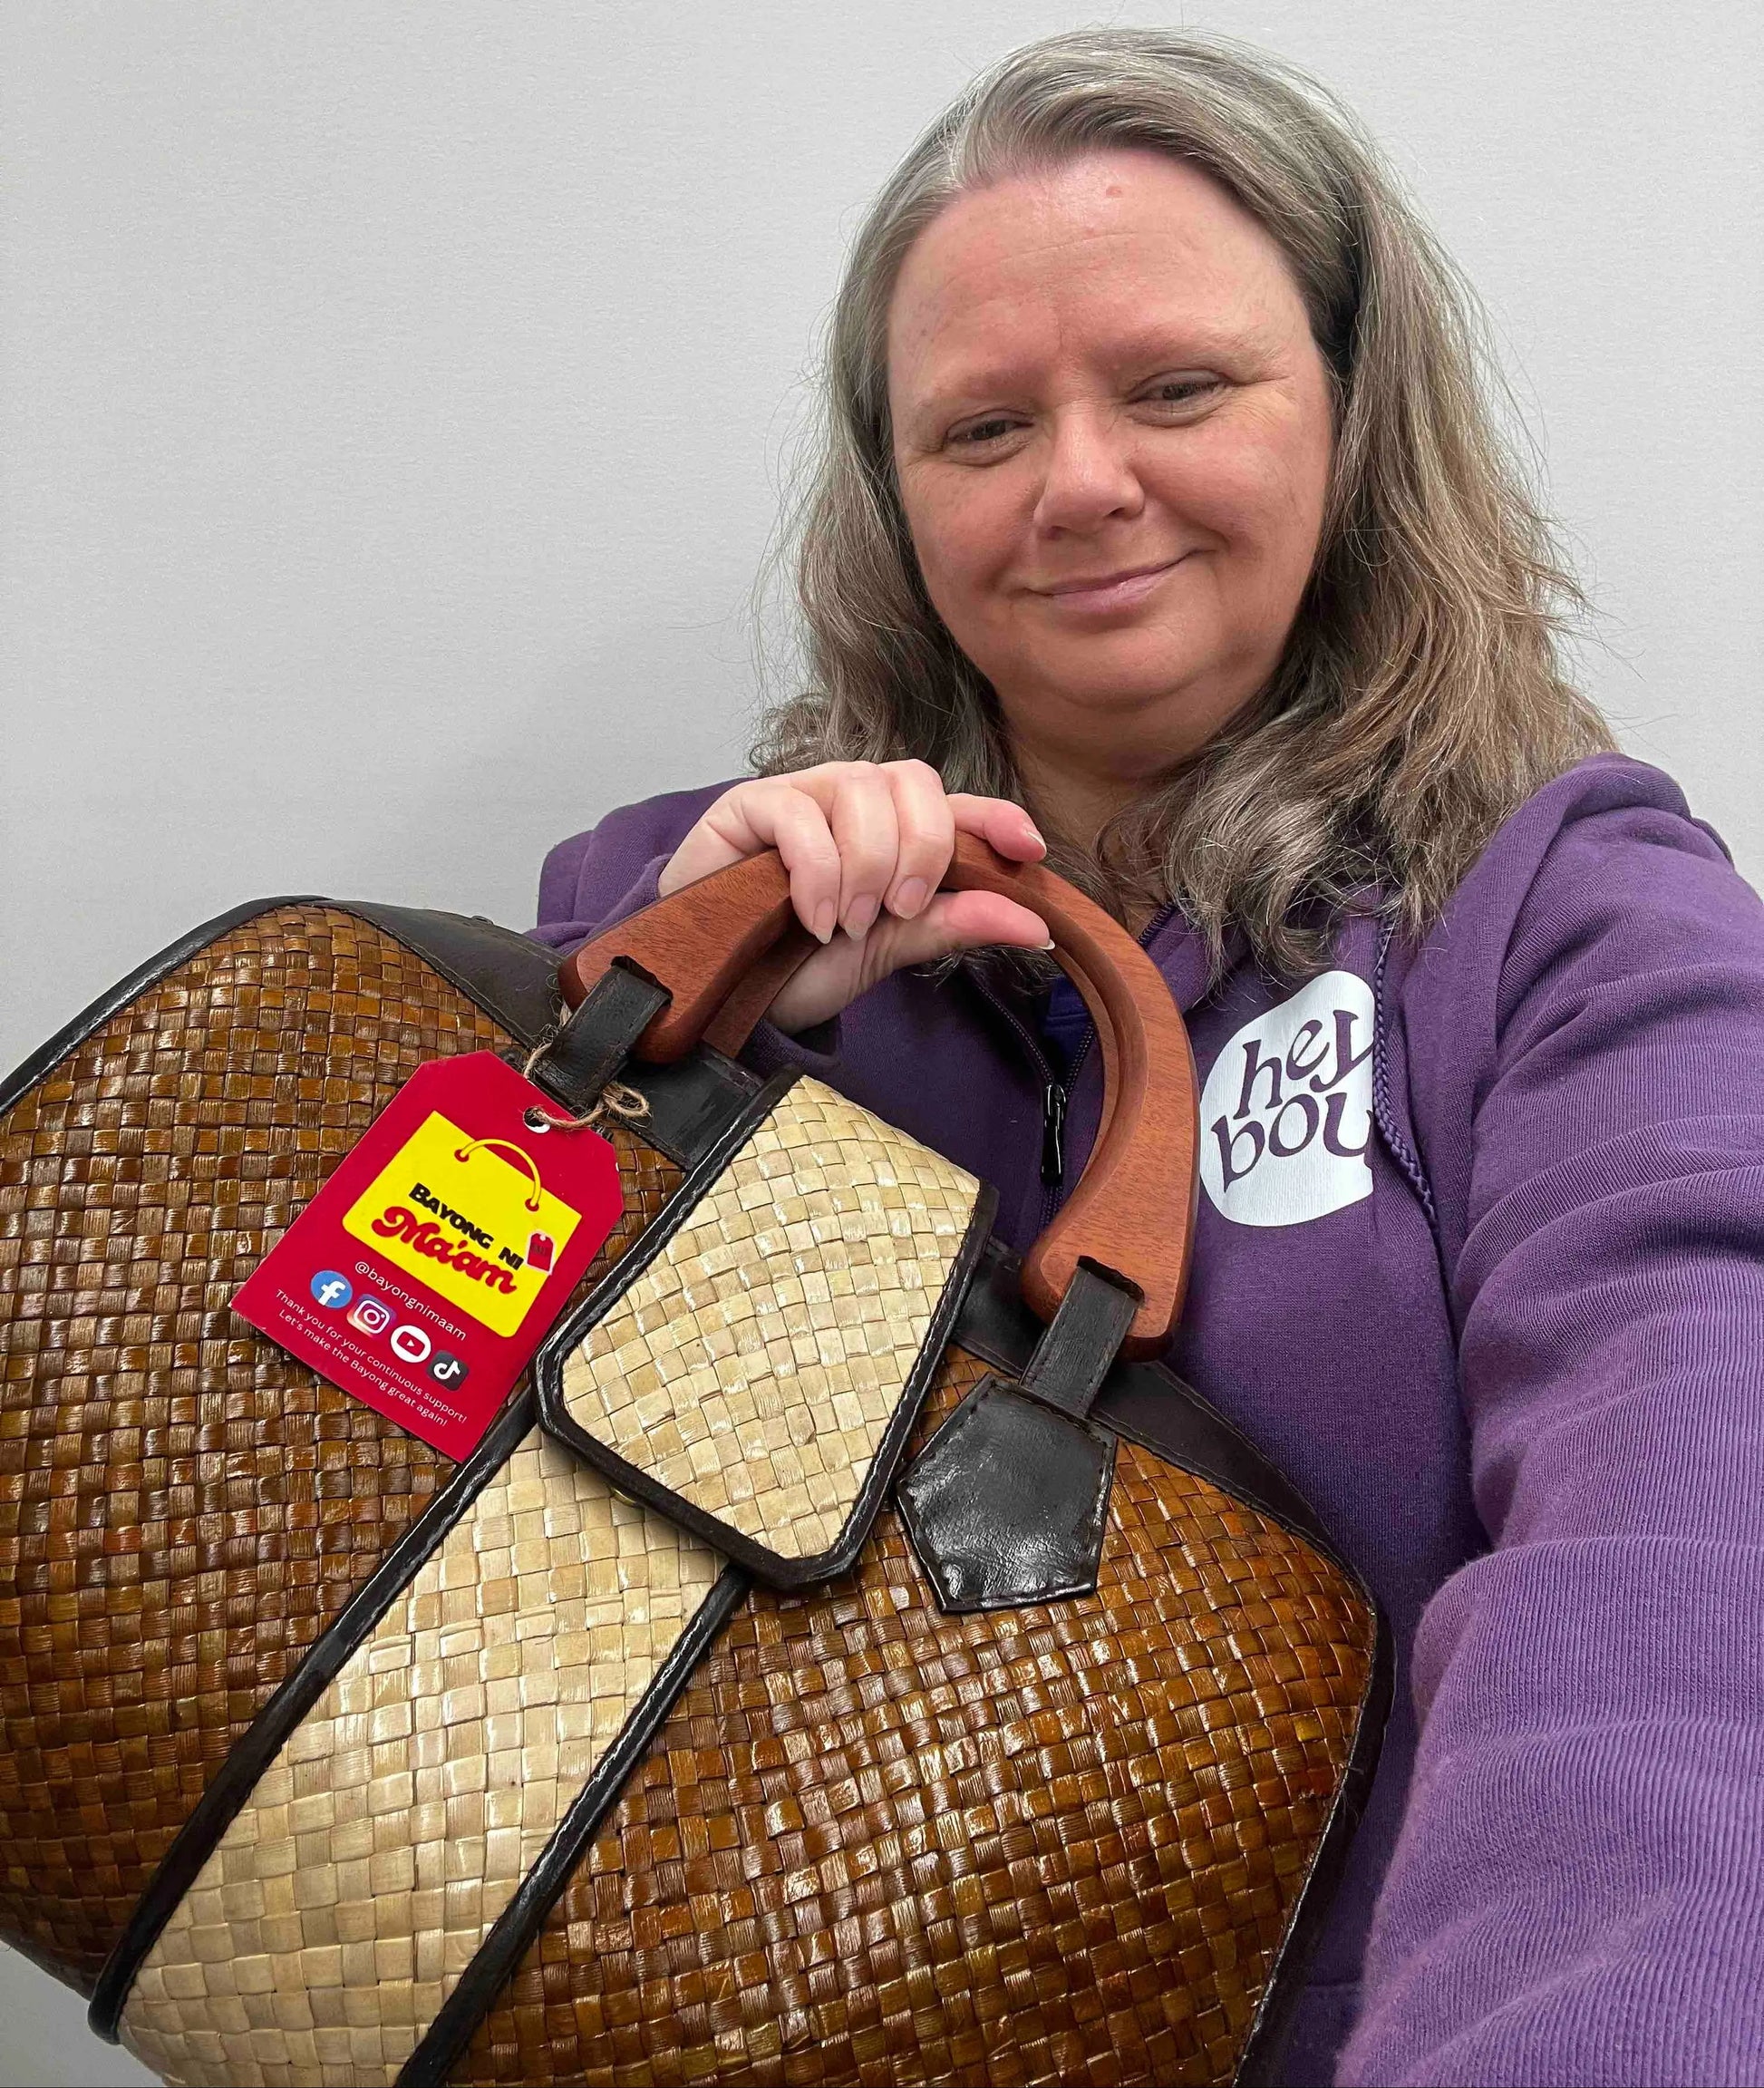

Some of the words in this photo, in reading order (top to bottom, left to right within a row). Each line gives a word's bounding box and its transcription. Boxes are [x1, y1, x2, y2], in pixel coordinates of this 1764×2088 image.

[372, 1206, 518, 1295] Ma'am
[409, 1182, 494, 1249] BAYONG
[499, 1247, 524, 1270] NI
[354, 1261, 467, 1341] @bayongnimaam
[276, 1289, 305, 1316] Thank
[304, 1313, 325, 1330] you
[326, 1326, 343, 1340] for
[341, 1338, 367, 1357] your
[367, 1355, 422, 1395] continuous
[423, 1393, 468, 1423] support!
[278, 1309, 303, 1331] Let's
[304, 1327, 331, 1350] make
[332, 1347, 350, 1363] the
[350, 1360, 389, 1391] Bayong
[387, 1386, 416, 1407] great
[417, 1404, 448, 1427] again!
